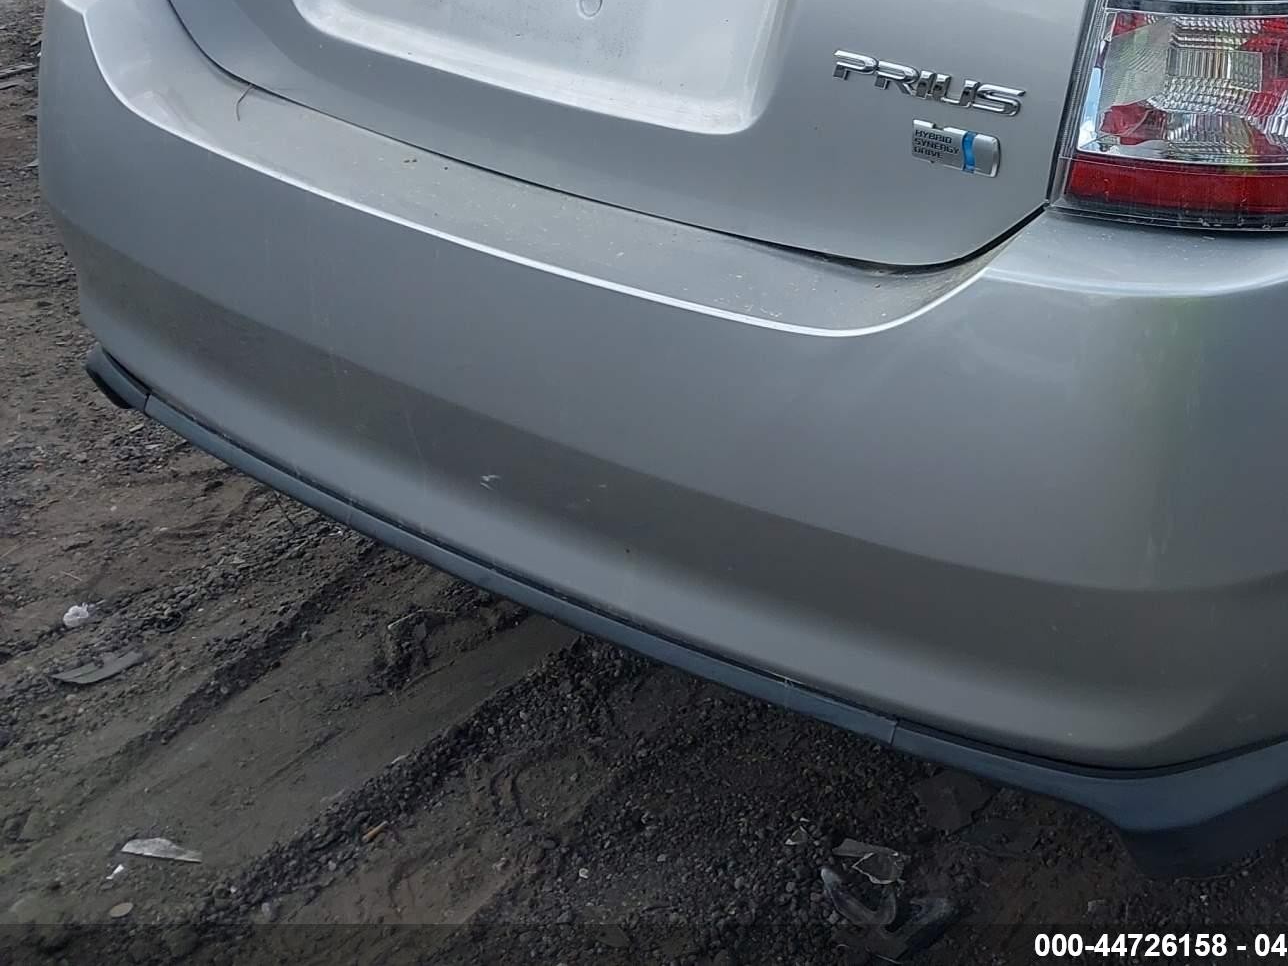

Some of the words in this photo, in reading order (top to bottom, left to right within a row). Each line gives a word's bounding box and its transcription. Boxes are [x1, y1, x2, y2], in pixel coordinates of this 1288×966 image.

[833, 50, 1026, 116] PRIUS
[915, 129, 952, 144] HYBRID
[913, 146, 943, 159] DRIVE
[914, 138, 960, 154] SYNERGY
